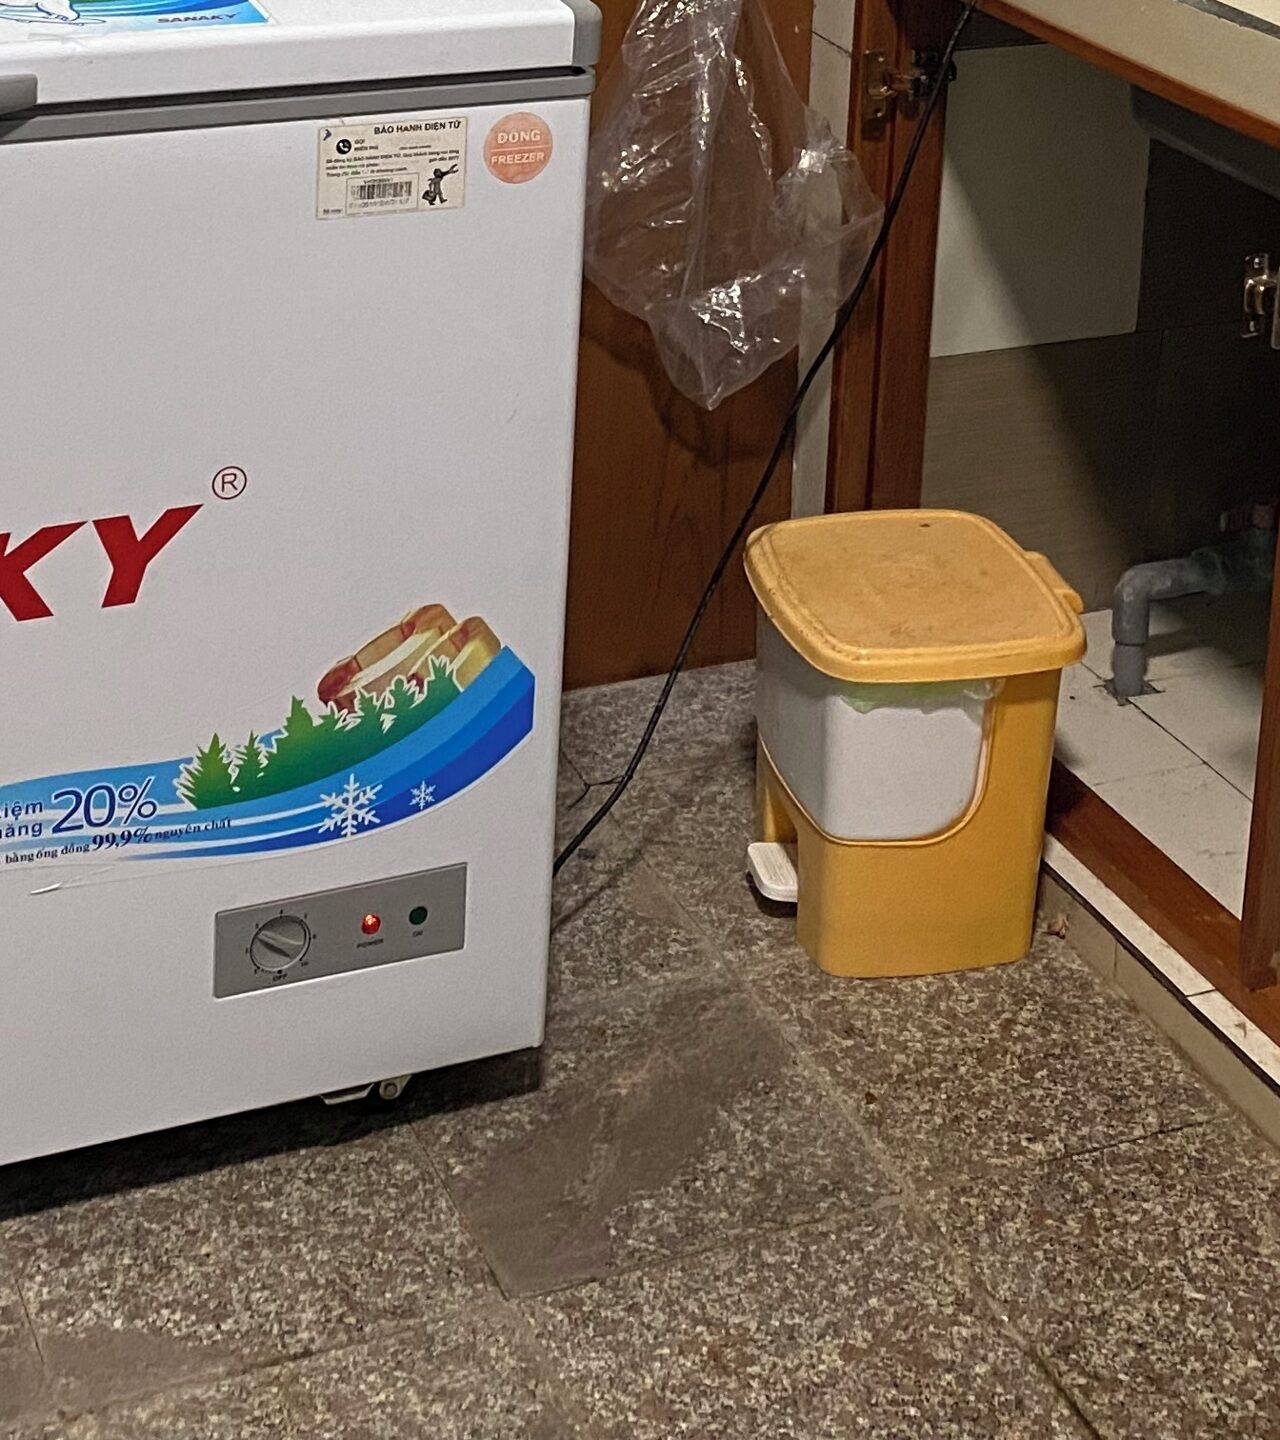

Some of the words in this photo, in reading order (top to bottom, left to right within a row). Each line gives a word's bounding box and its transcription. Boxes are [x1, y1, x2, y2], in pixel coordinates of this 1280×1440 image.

[157, 13, 237, 24] SANAKY
[490, 151, 546, 166] FREEZER
[51, 777, 158, 835] 20%
[154, 822, 202, 840] nguyên
